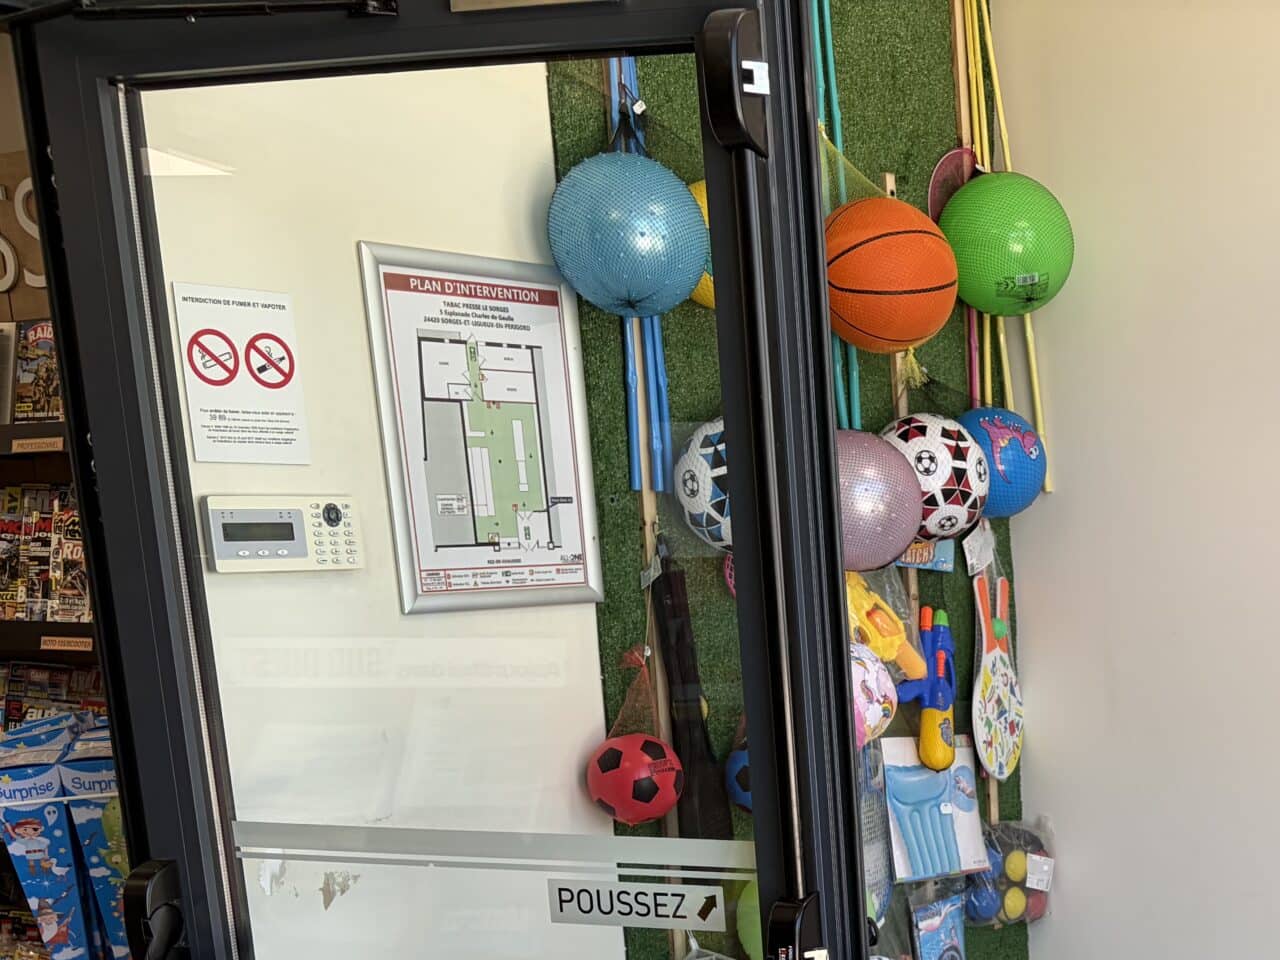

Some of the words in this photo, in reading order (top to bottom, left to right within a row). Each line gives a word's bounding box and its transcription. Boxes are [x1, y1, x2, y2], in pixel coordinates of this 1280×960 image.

[181, 296, 222, 305] INTERDICTION
[232, 300, 251, 308] FUMER
[409, 278, 441, 293] PLAN
[444, 282, 539, 303] D'INTERVENTION
[443, 300, 462, 309] TABAC
[901, 541, 935, 564] ATCHY
[558, 887, 688, 920] POUSSEZ
